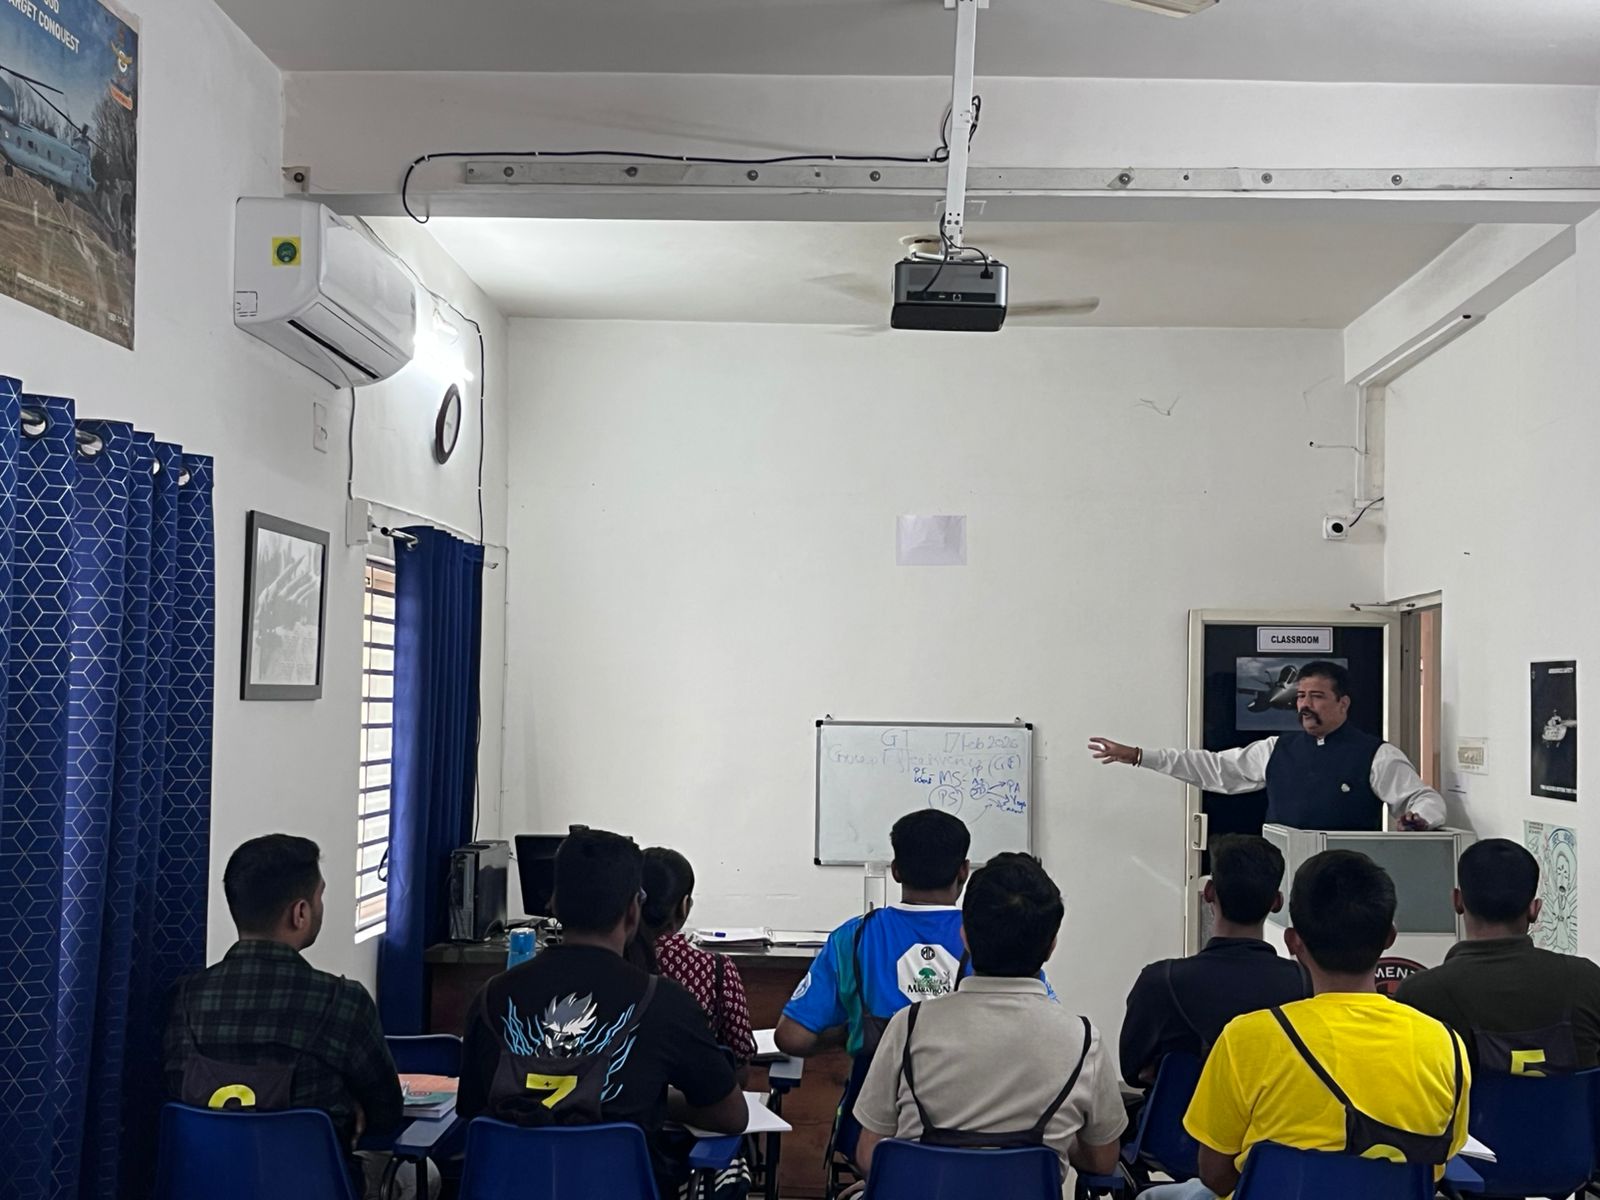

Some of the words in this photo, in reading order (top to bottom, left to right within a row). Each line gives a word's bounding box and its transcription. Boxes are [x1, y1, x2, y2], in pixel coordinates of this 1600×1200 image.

[38, 10, 80, 54] CONQUEST
[1270, 635, 1320, 645] CLASSROOM
[1374, 966, 1416, 979] MEN
[525, 1073, 578, 1110] 7
